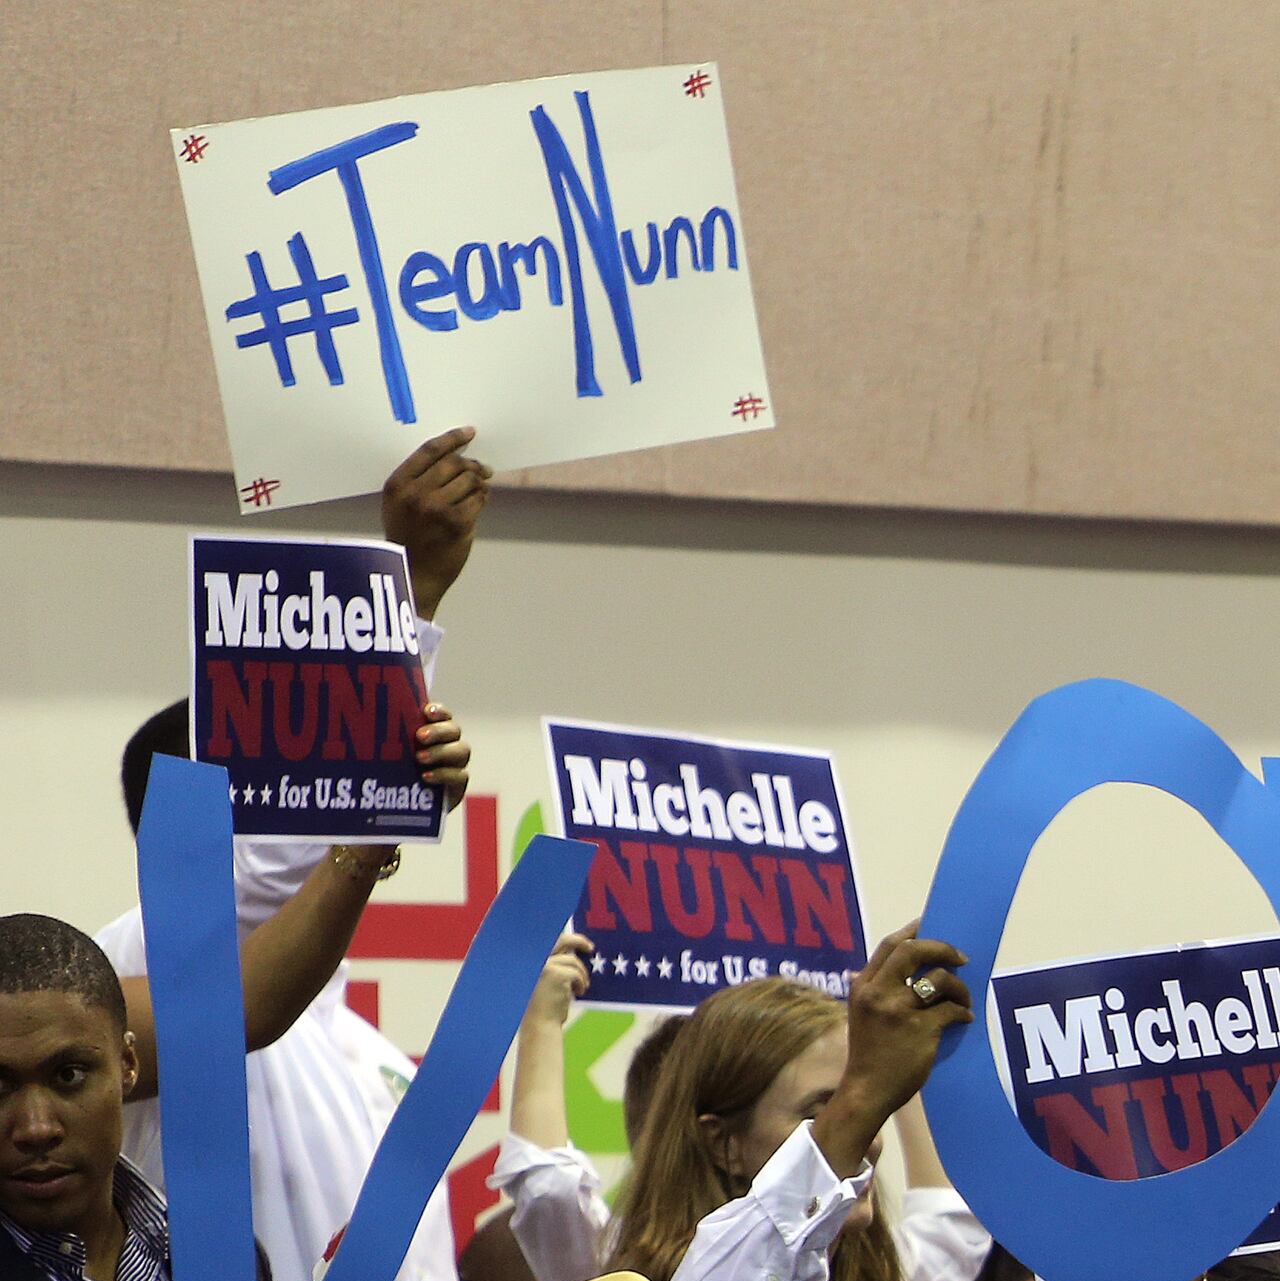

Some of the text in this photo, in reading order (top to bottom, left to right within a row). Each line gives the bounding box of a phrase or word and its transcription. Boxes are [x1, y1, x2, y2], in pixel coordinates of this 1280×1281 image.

[225, 90, 739, 425] #TeamNunn
[203, 569, 419, 656] Michelle
[278, 774, 434, 811] for U.S. Senate
[563, 754, 839, 854] Michelle
[581, 836, 856, 952] NUNN
[680, 949, 718, 985] for
[778, 960, 850, 998] Senat
